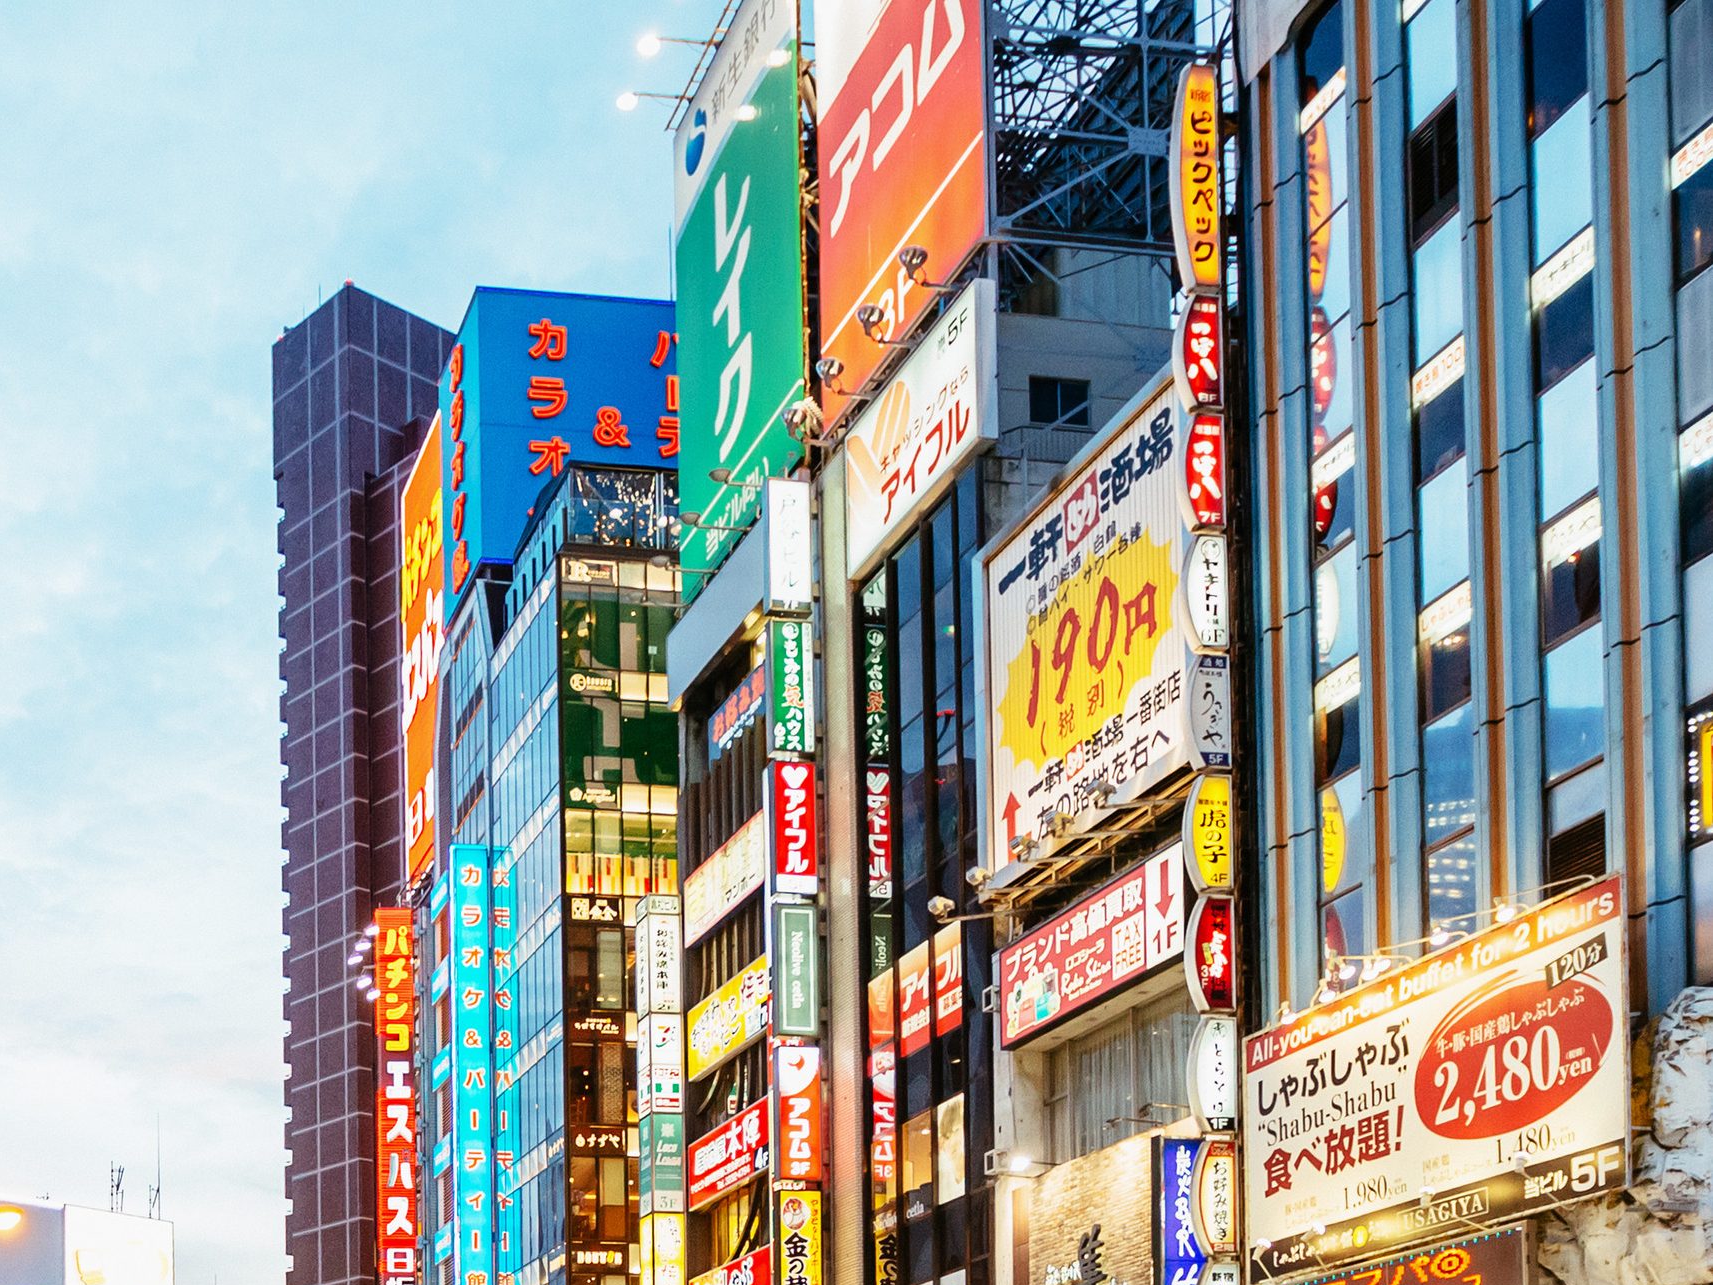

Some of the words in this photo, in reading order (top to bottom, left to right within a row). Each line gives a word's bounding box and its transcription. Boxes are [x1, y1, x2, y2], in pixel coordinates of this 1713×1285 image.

[830, 0, 965, 240] アコム
[712, 172, 754, 464] レイク
[948, 307, 968, 347] 5F
[527, 318, 571, 477] カラオ
[593, 406, 630, 447] &
[879, 365, 969, 474] キャッシングなら
[881, 399, 971, 525] アイフル
[998, 406, 1174, 596] 一軒め酒場
[1198, 510, 1222, 523] 7F
[1026, 575, 1158, 729] 190円
[1200, 628, 1225, 644] 6F
[781, 640, 805, 751] もみの気ハウス
[1208, 752, 1224, 766] 5F
[784, 788, 809, 874] アイフル
[1200, 809, 1227, 864] 虎の子
[1210, 872, 1229, 884] 4F
[791, 930, 804, 978] Neolive
[1005, 877, 1144, 983] ブランド高価買取
[1114, 919, 1142, 944] TAX
[1151, 919, 1179, 955] 1F
[1115, 941, 1143, 972] FREE
[1251, 986, 1396, 1066] All-you-can-eat
[1397, 951, 1467, 1010] buffet
[1471, 934, 1502, 971] for
[1511, 921, 1532, 953] 2
[1536, 891, 1615, 943] hours
[1547, 941, 1603, 988] 120分
[384, 925, 410, 1052] パチンコ
[1257, 1020, 1411, 1118] しゃぶしゃぶ
[788, 1097, 812, 1159] アコム
[1210, 1117, 1230, 1131] 1F
[789, 1161, 811, 1176] 3F
[1523, 1168, 1569, 1200] 当ビル
[1569, 1146, 1621, 1193] 5F
[1213, 1160, 1229, 1241] お好み焼き
[1403, 1192, 1485, 1231] USAGIYA
[576, 1250, 623, 1265] DOUTOR
[1211, 1271, 1235, 1283] 新宿
